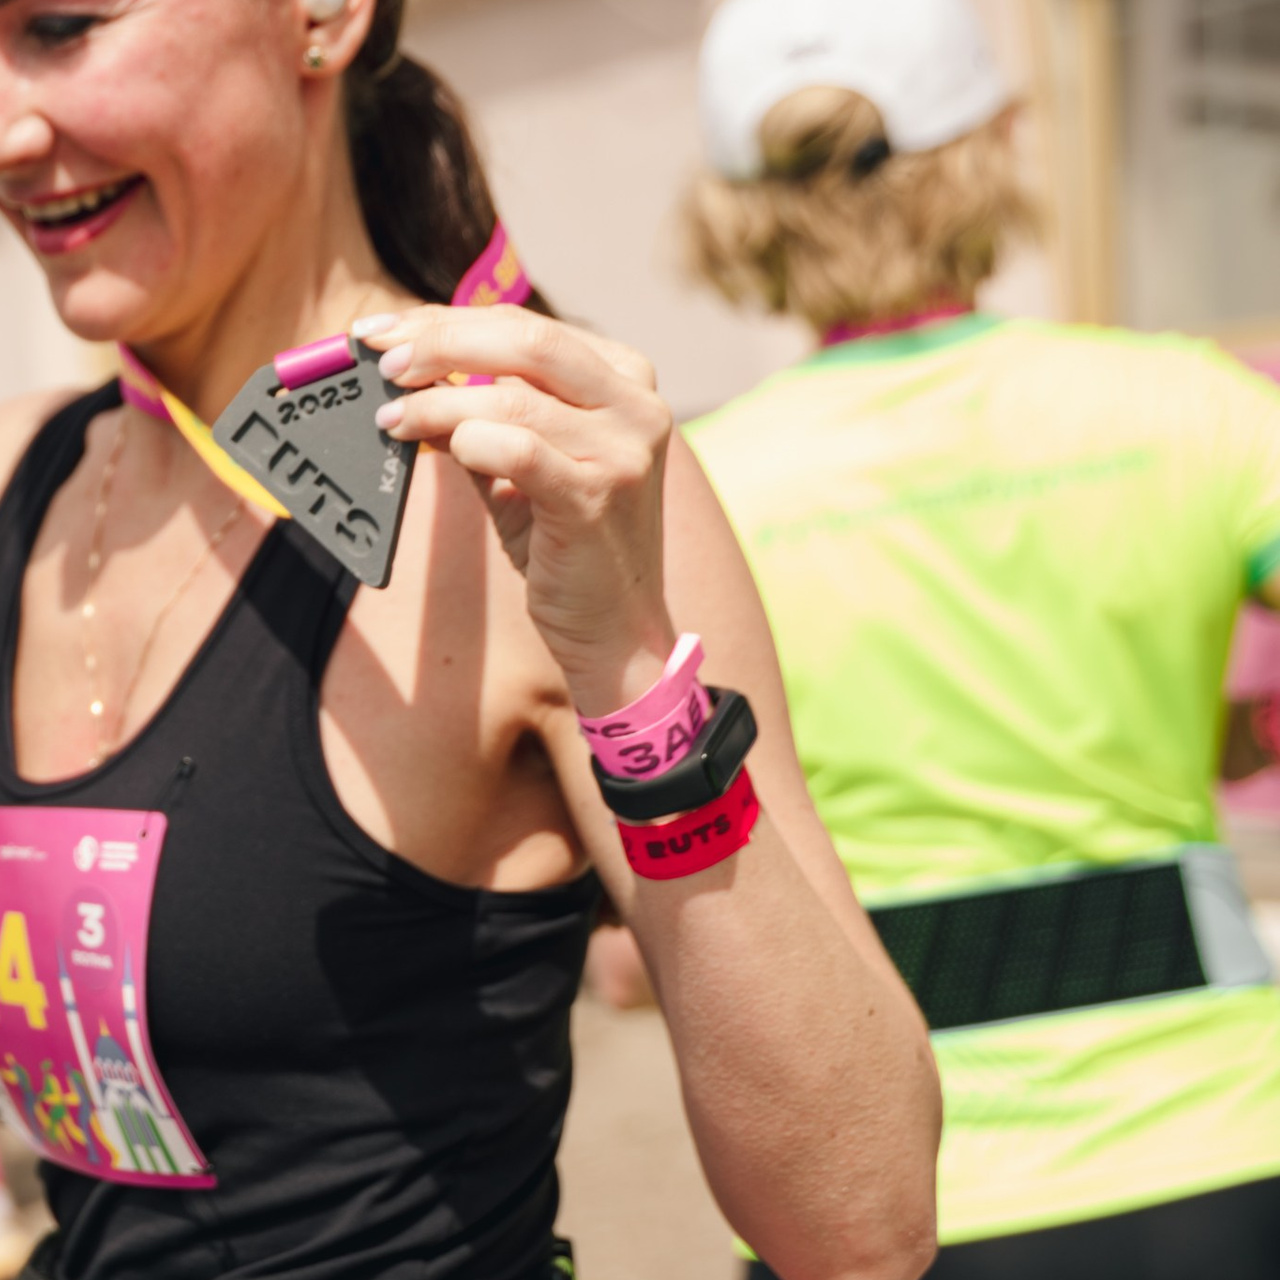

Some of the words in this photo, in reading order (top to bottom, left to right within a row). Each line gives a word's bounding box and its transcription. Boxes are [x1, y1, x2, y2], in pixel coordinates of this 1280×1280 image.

[277, 376, 363, 425] 2023
[646, 813, 732, 860] RUTS
[77, 902, 106, 949] 3
